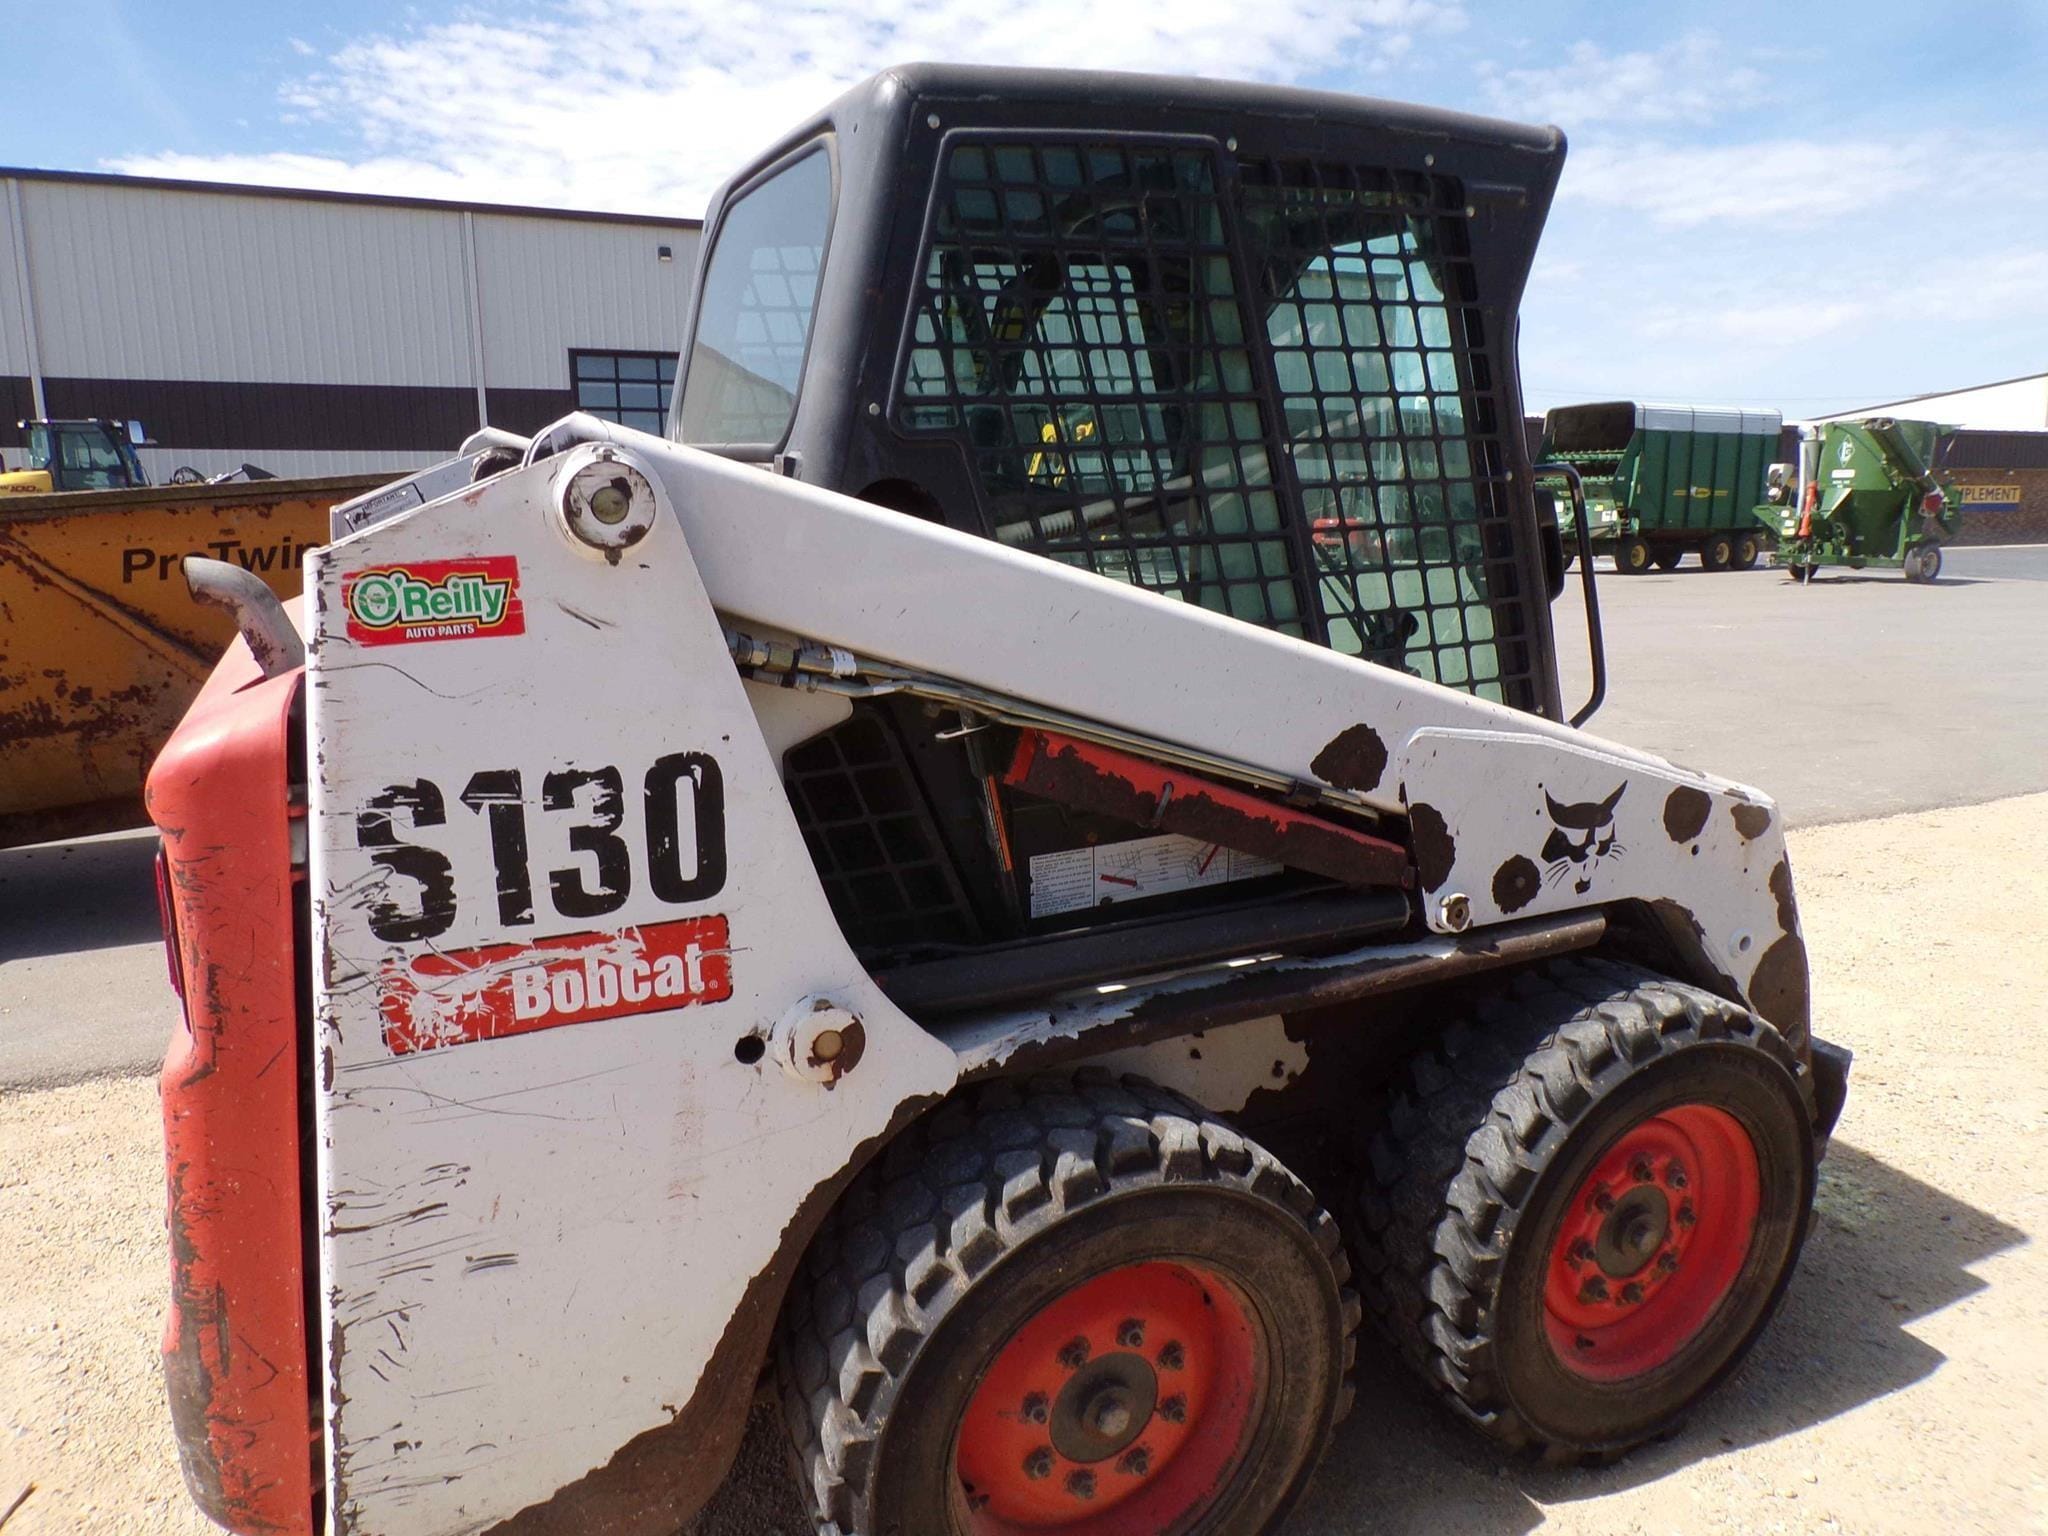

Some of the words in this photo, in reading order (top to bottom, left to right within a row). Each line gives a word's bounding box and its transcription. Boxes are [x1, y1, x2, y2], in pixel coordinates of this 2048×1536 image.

[357, 574, 501, 621] O'Reilly
[405, 626, 435, 639] AUTO
[438, 623, 475, 637] PARTS
[357, 751, 728, 943] S130
[511, 943, 705, 1021] Bobcat
